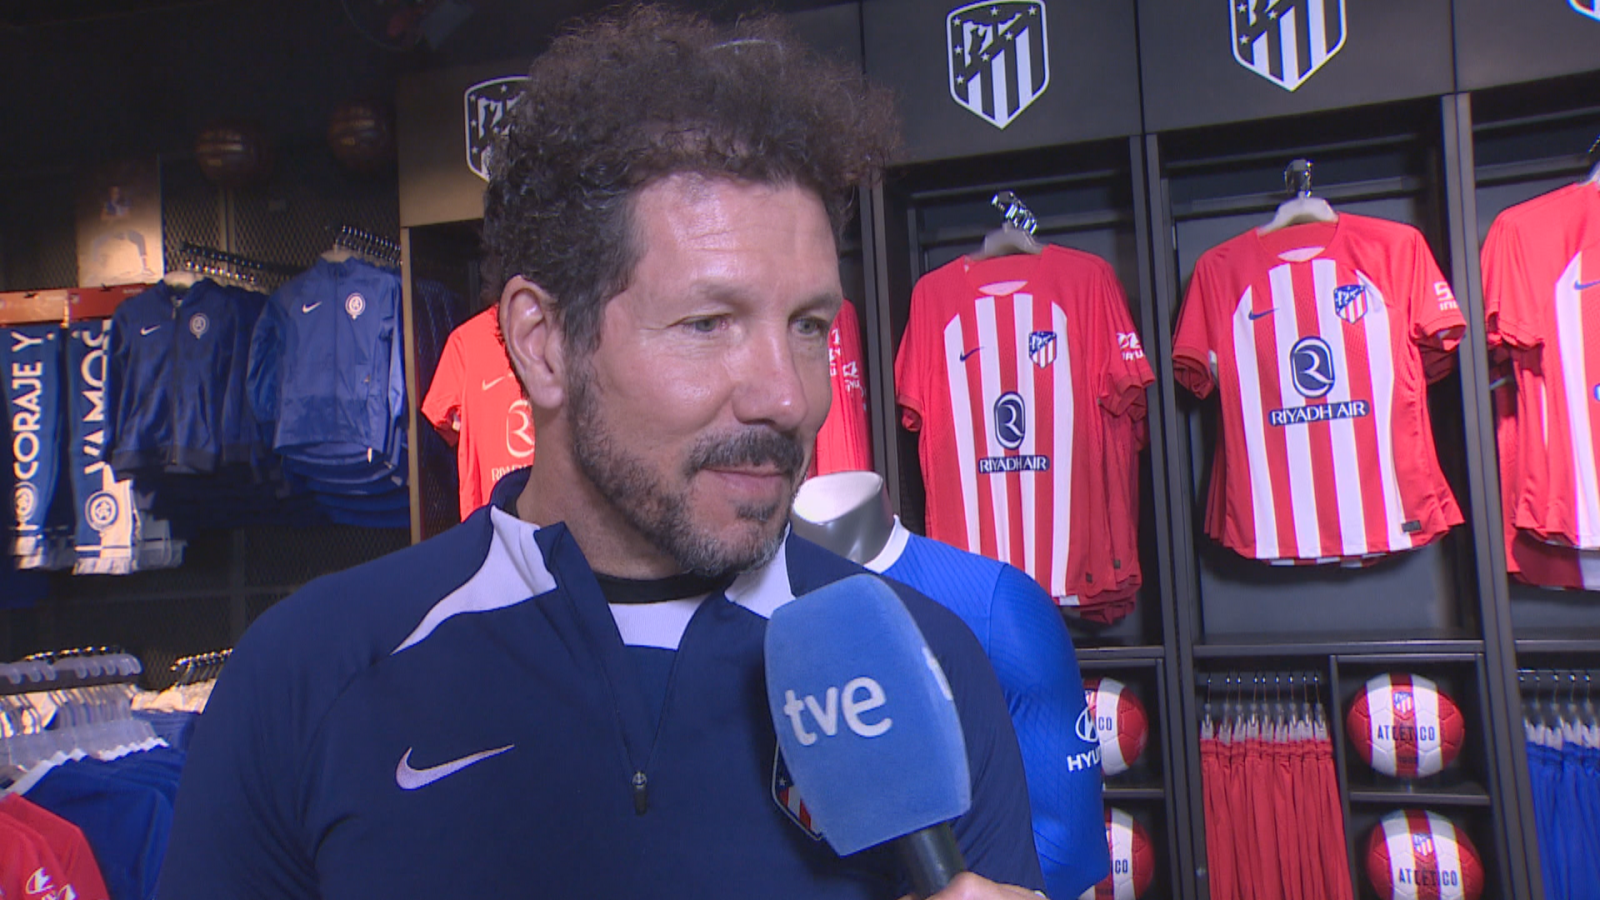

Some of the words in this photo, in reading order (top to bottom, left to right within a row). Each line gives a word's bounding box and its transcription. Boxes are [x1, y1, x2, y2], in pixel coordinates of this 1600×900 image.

[11, 331, 43, 352] Y
[12, 362, 42, 480] CORAJE
[1271, 404, 1331, 425] RIYADH
[1336, 401, 1366, 418] AIR
[979, 457, 1021, 473] RIYADH
[1023, 456, 1047, 470] AIR
[783, 676, 893, 746] tve
[1377, 723, 1435, 742] ATLÉTICO
